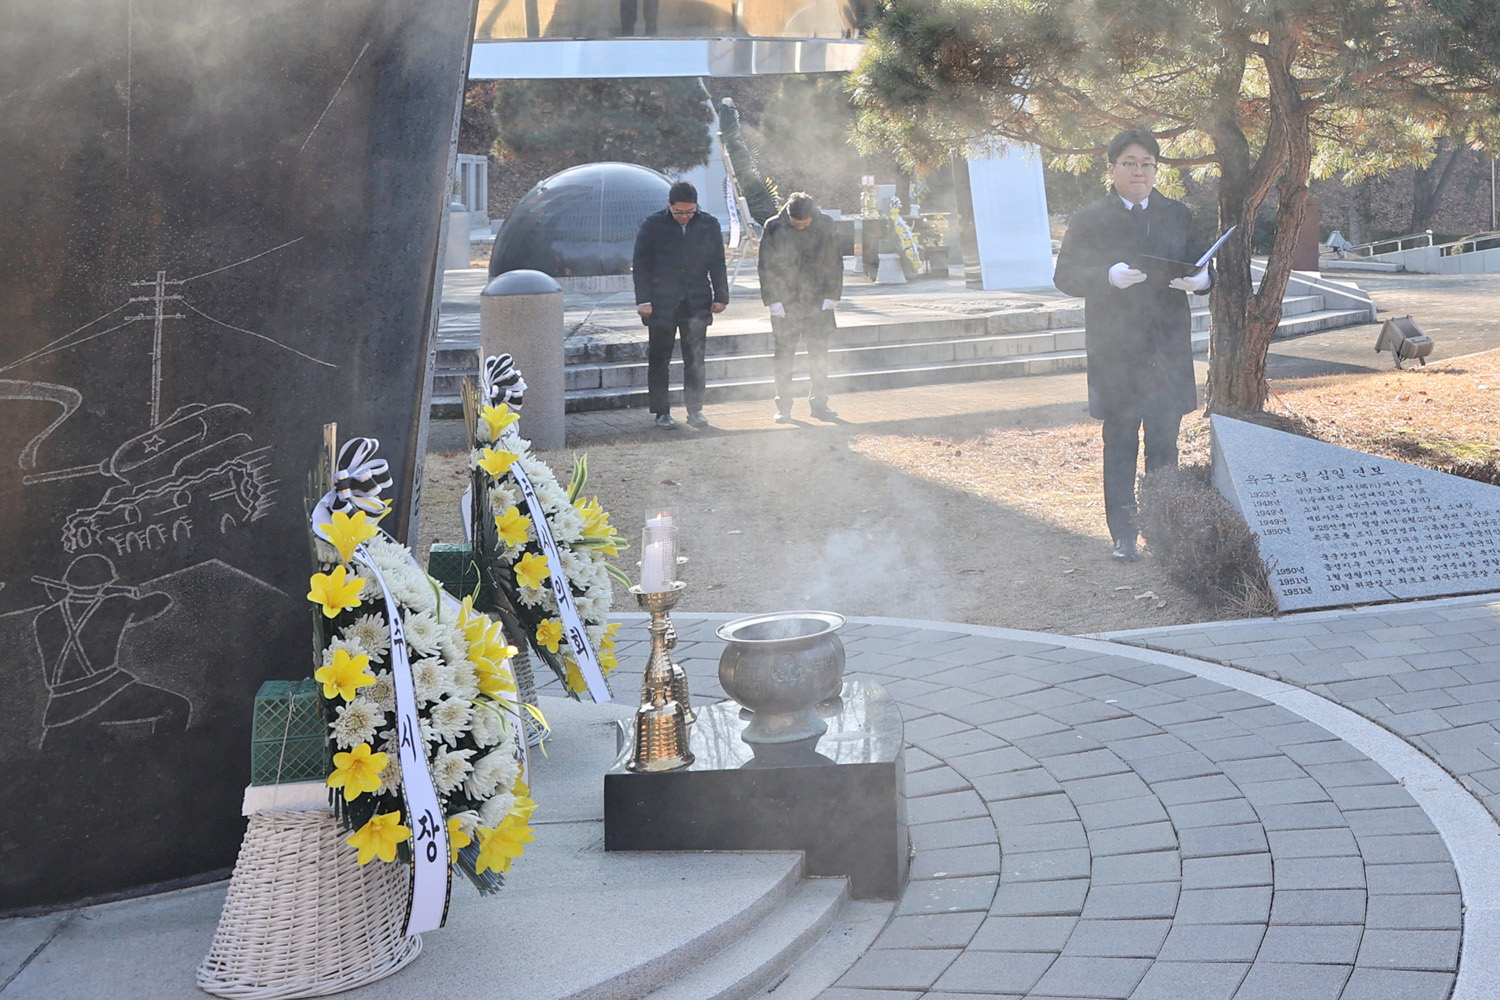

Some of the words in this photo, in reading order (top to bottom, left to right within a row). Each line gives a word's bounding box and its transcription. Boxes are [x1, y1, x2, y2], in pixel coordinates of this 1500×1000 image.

[1245, 470, 1308, 484] 육군소령
[1317, 467, 1345, 480] 심일
[1352, 465, 1384, 477] 연보
[1249, 489, 1276, 497] 1923년
[1252, 499, 1280, 507] 1948년
[1299, 494, 1345, 503] 서울대학교
[1349, 490, 1385, 499] 사범대학
[1255, 508, 1283, 516] 1949년
[1303, 505, 1320, 513] 소위
[1325, 503, 1343, 511] 임관
[1259, 517, 1287, 525] 1949년
[1306, 513, 1339, 521] 제6사단
[1344, 510, 1377, 518] 제7연대
[1447, 501, 1472, 510] 소대장
[1262, 526, 1290, 535] 1950년
[512, 463, 590, 661] 주시의회
[1275, 566, 1304, 575] 1950년
[1278, 576, 1308, 585] 1951년
[1325, 573, 1341, 581] 1월
[1387, 565, 1425, 575] 전투에서
[1282, 586, 1312, 596] 1951년
[1329, 582, 1349, 592] 10월
[1431, 569, 1488, 580] 태극무공훈장
